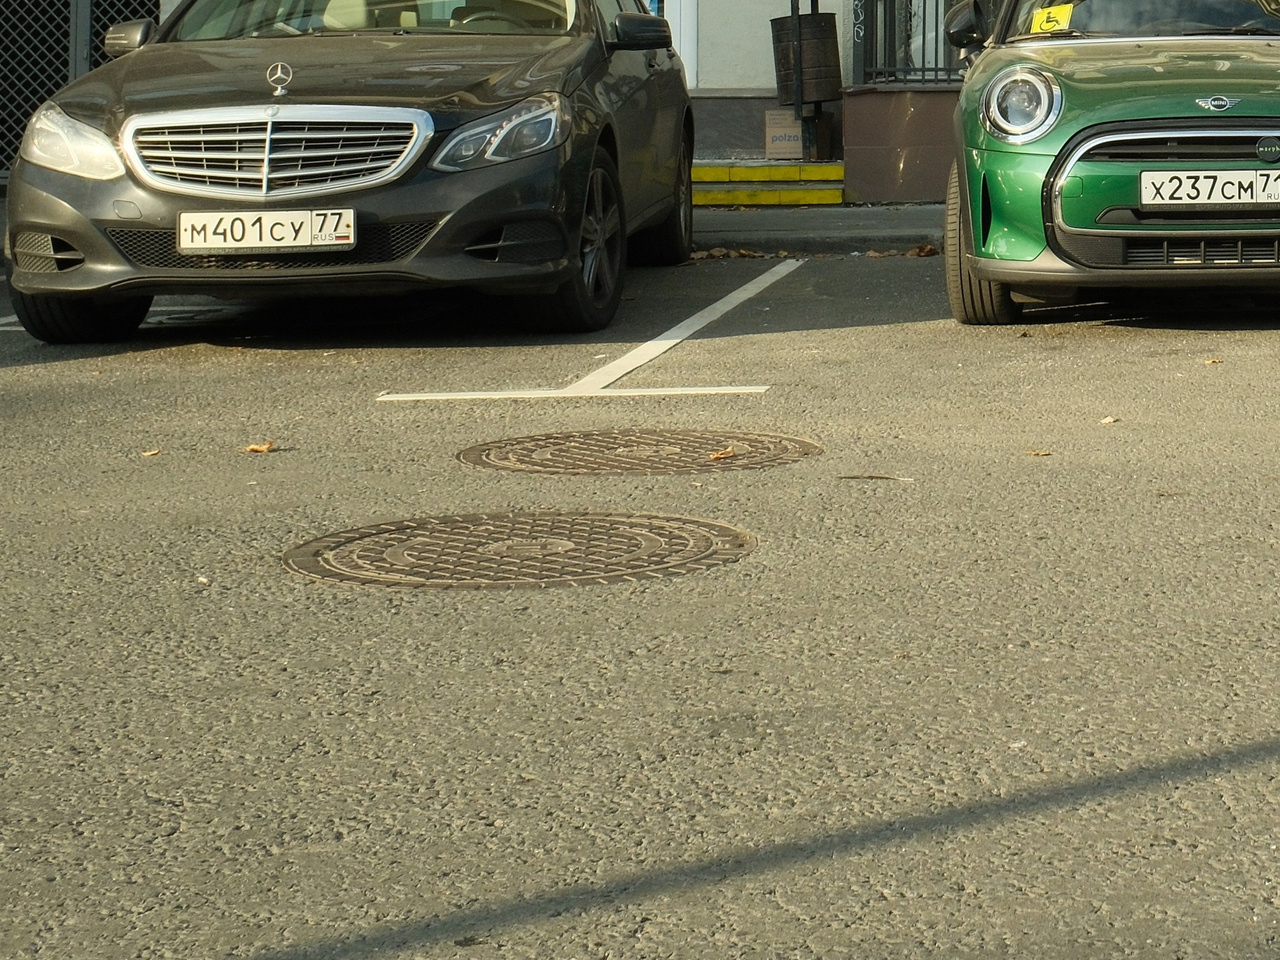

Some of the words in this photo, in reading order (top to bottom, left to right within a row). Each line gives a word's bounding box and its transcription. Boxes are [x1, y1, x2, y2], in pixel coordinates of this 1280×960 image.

[1151, 175, 1254, 200] Х237СМ
[190, 216, 305, 243] М401СУ
[315, 212, 343, 233] 77
[313, 233, 334, 241] RUS
